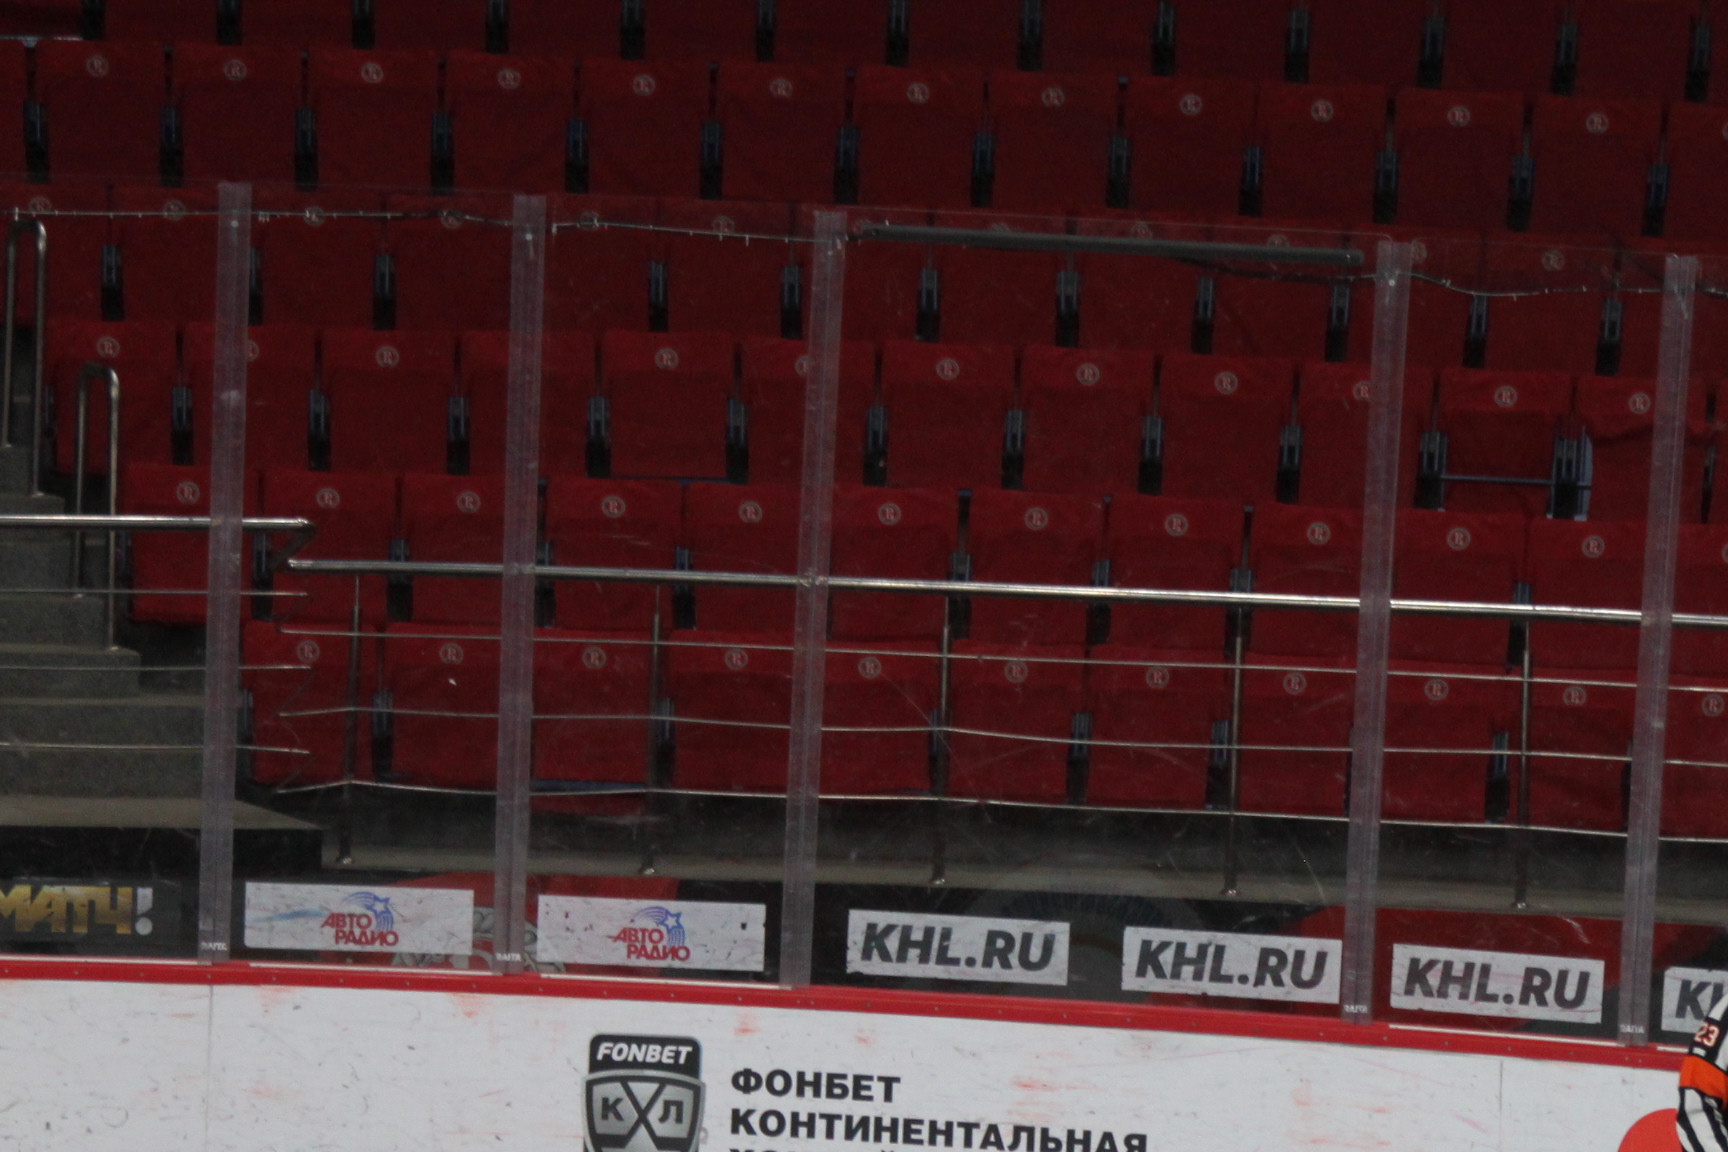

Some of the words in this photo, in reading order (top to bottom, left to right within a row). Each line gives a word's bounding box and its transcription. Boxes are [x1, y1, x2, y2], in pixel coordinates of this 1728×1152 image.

[320, 912, 372, 930] АВТО
[335, 929, 399, 947] РАДИО
[611, 927, 664, 945] АВТО
[860, 922, 1055, 971] KHL.RU
[626, 943, 691, 963] РАДИО
[1134, 939, 1327, 989] KHL.RU
[1402, 956, 1589, 1010] KHL.RU
[1694, 1022, 1721, 1047] 23
[597, 1042, 693, 1066] FONBET
[731, 1068, 901, 1103] ФОНБЕТ
[601, 1097, 624, 1123] К
[658, 1098, 685, 1124] Л
